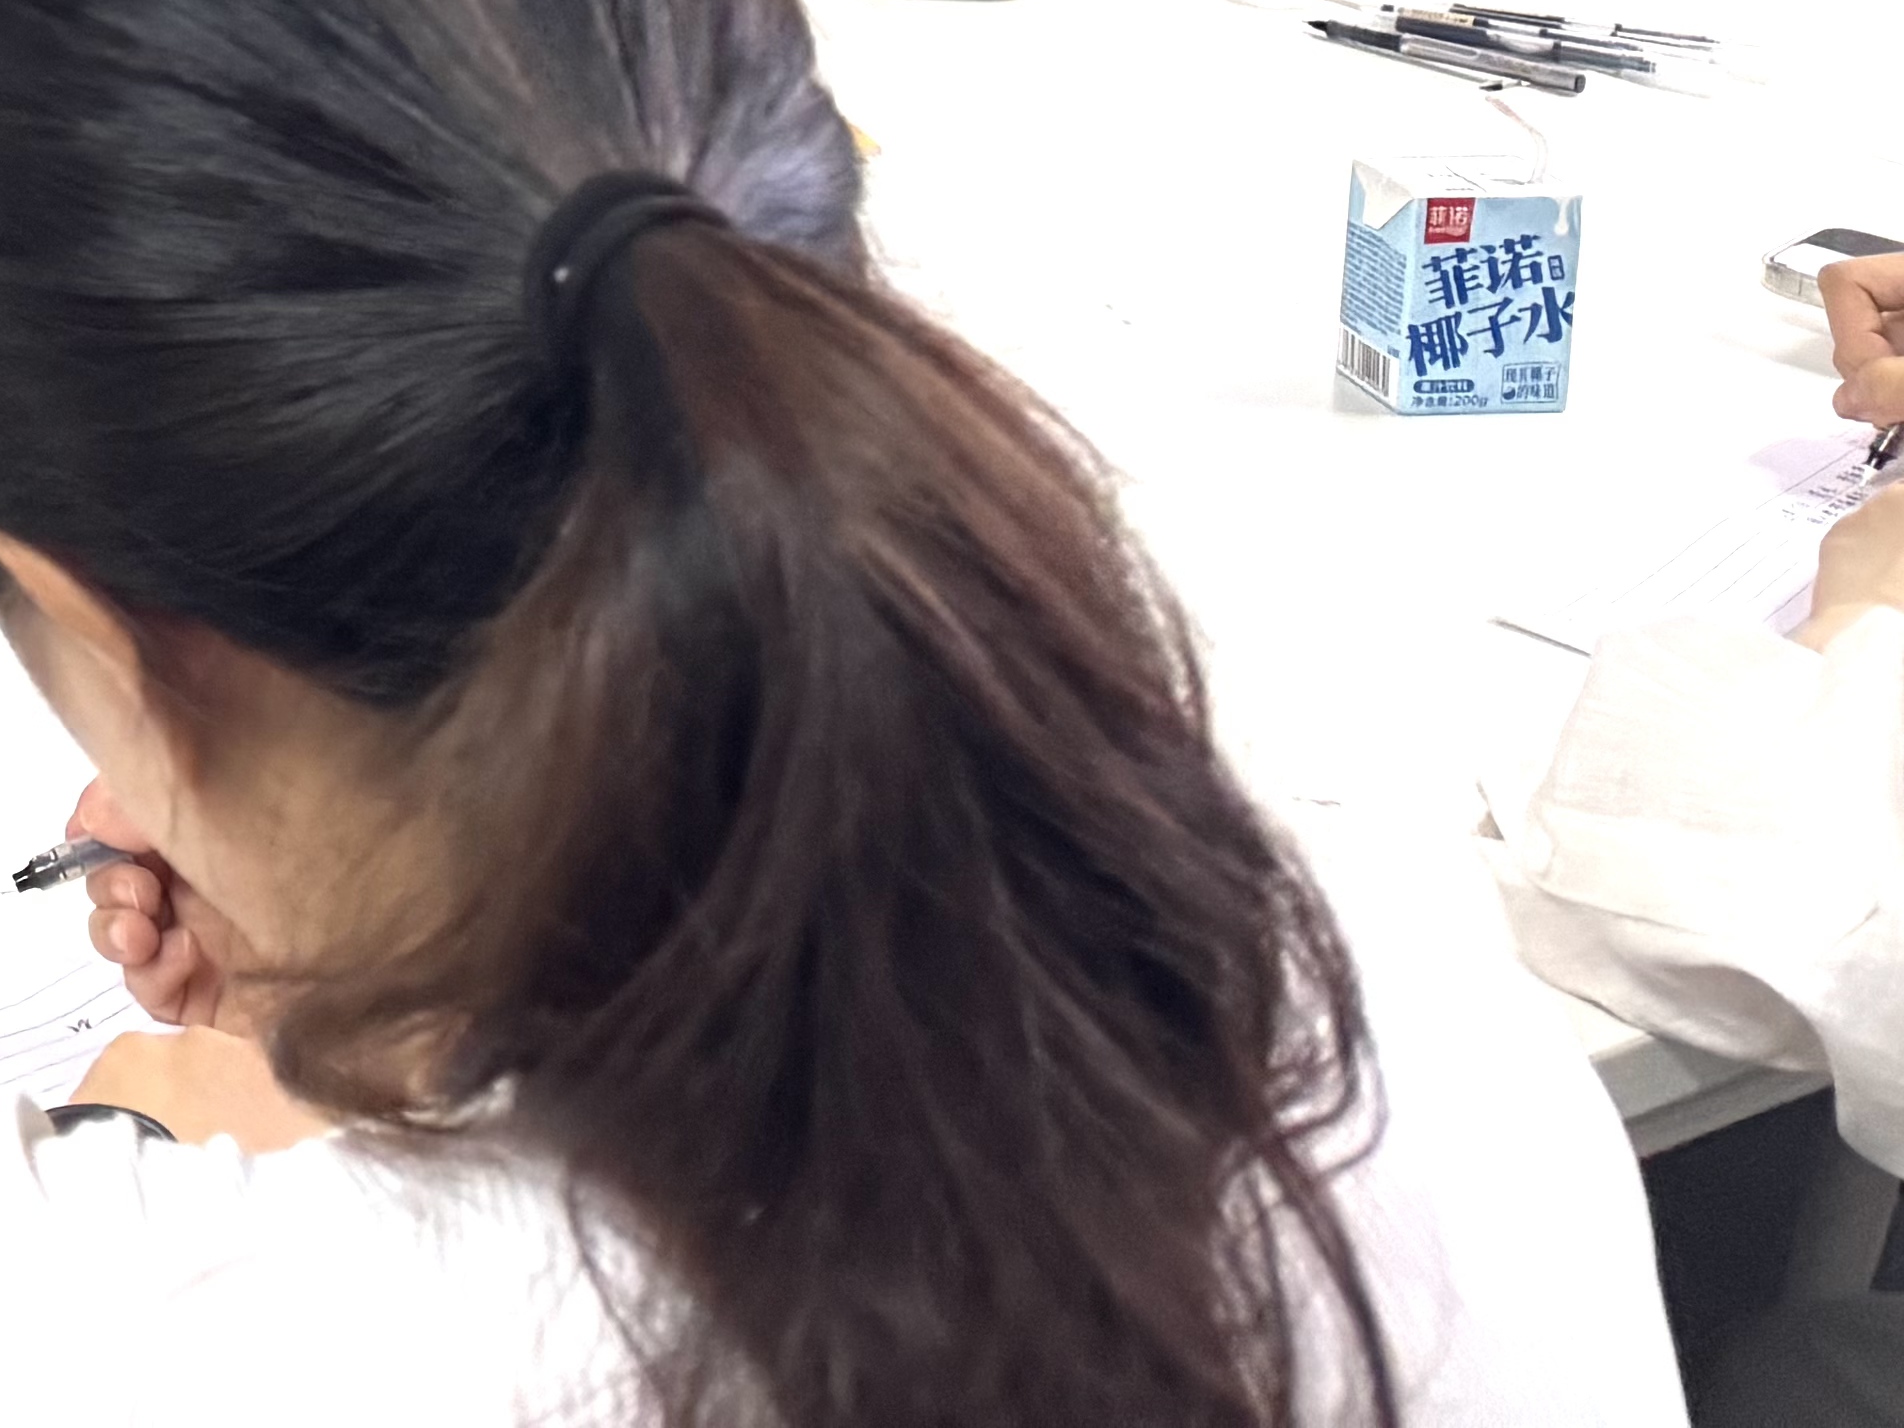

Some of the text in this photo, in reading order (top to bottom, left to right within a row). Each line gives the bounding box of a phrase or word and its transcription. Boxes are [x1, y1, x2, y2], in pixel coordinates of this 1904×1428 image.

[1422, 235, 1544, 309] 菲诺
[1406, 287, 1575, 377] 椰子水
